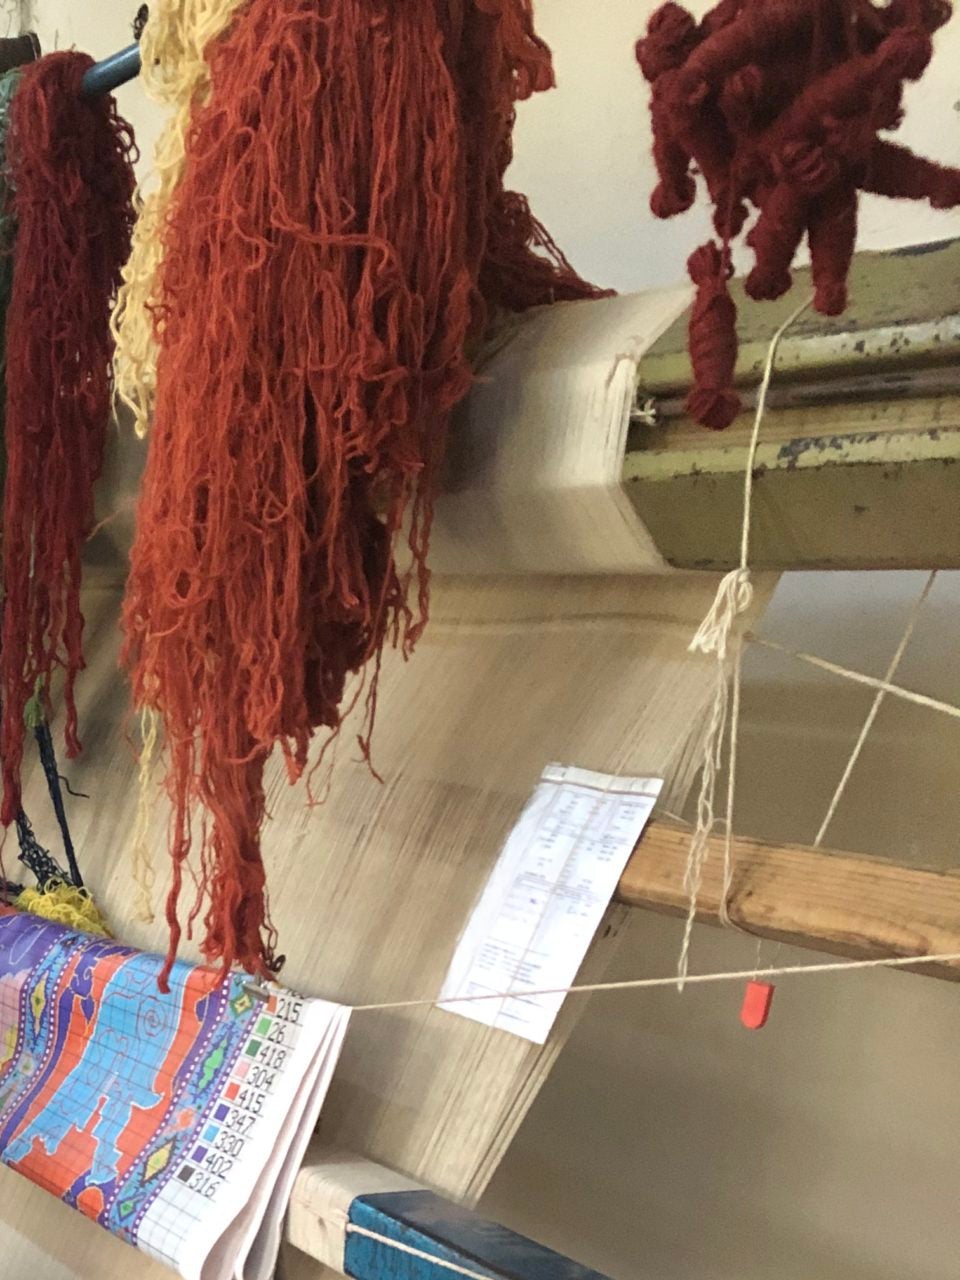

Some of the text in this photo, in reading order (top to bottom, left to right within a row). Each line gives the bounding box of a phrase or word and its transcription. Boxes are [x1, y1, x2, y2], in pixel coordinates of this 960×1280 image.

[276, 998, 303, 1023] 215
[268, 1022, 287, 1044] 26
[259, 1046, 287, 1070] 418
[247, 1066, 276, 1093] 304
[238, 1089, 266, 1113] 415
[226, 1109, 257, 1135] 347
[215, 1131, 245, 1157] 330
[204, 1153, 233, 1179] 402
[188, 1172, 220, 1198] 316
